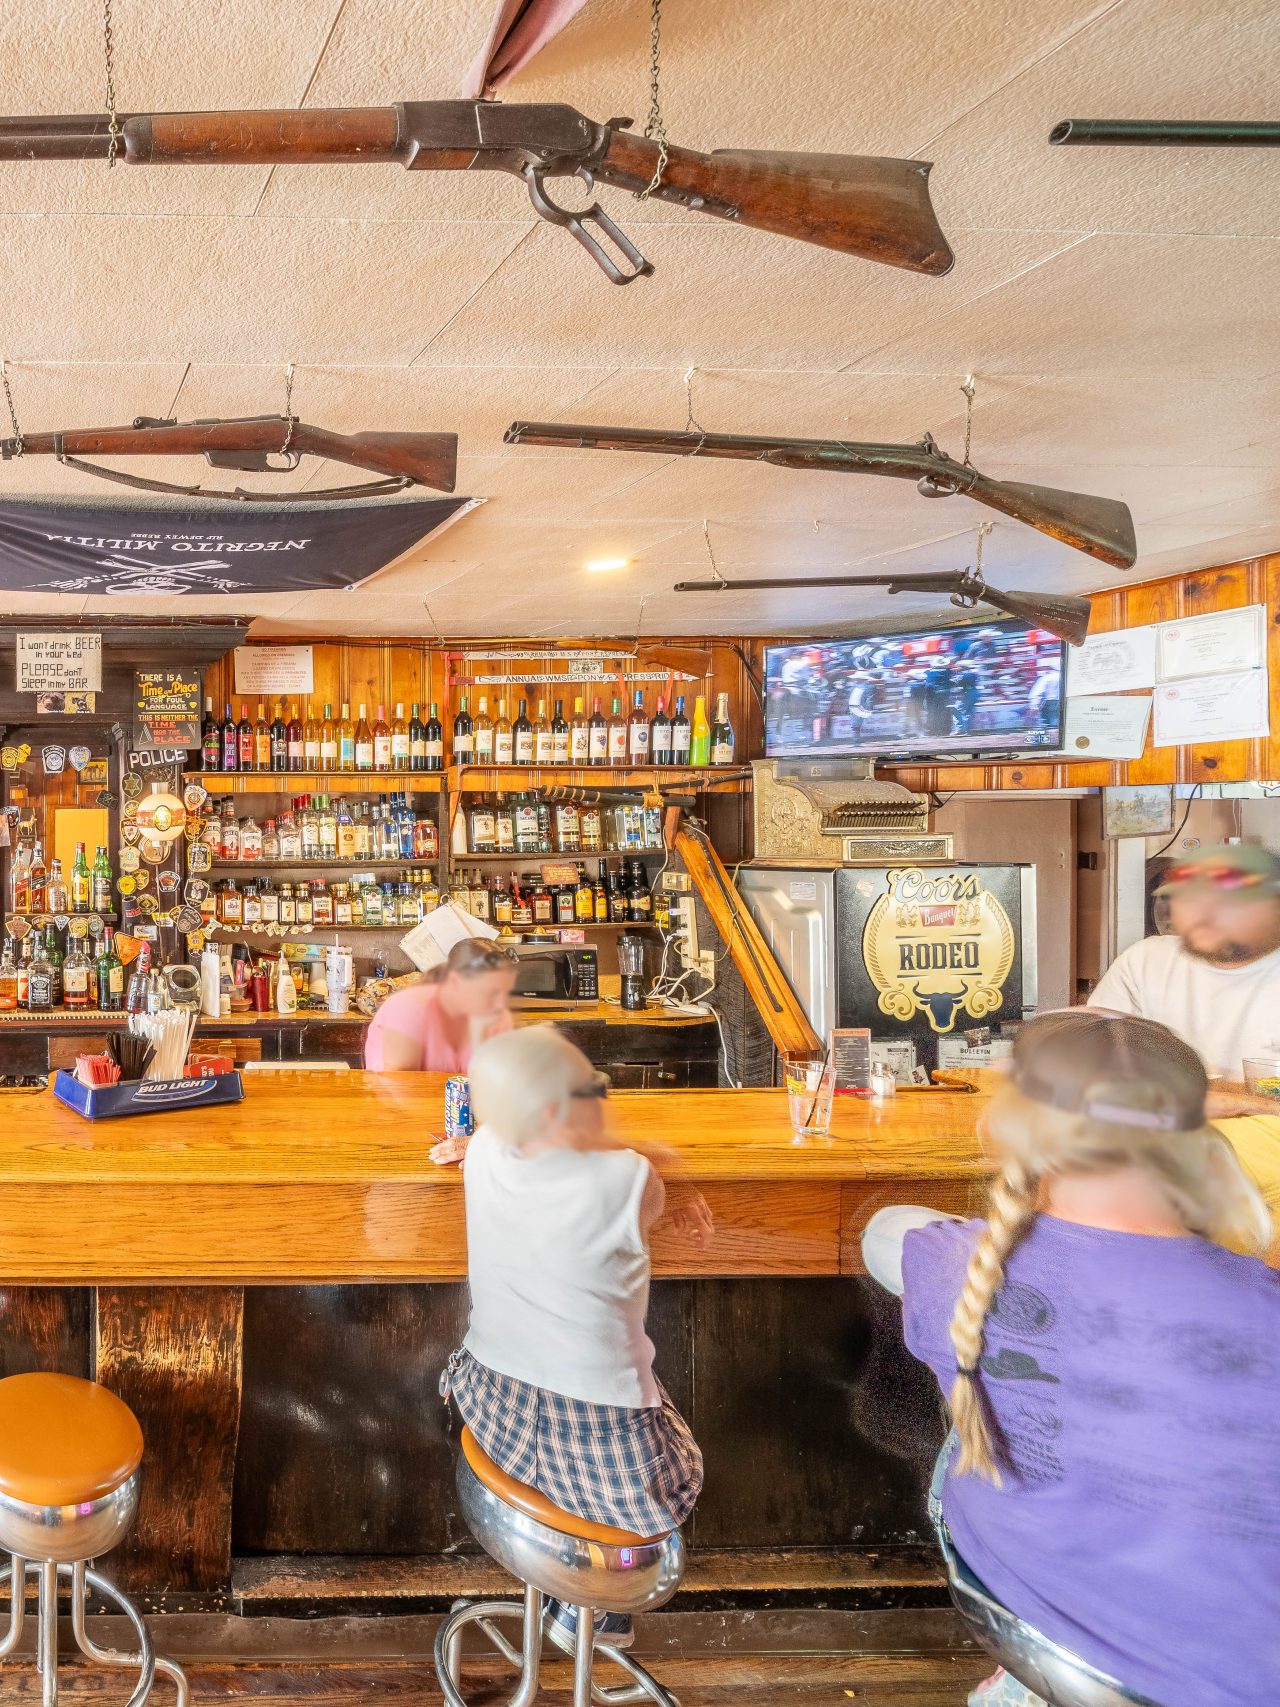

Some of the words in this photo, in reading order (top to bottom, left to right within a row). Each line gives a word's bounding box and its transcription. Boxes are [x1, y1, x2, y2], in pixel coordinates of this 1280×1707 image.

[44, 534, 165, 551] MILITIA
[171, 539, 312, 552] NEGRITO
[20, 637, 26, 650] I
[75, 637, 101, 650] BEER
[21, 662, 64, 677] PLEASE
[68, 677, 89, 689] BAR
[140, 674, 163, 682] THERE
[138, 682, 163, 696] Time
[172, 681, 198, 694] Place
[154, 736, 190, 744] PLACE
[129, 749, 186, 768] POLICE
[893, 870, 980, 903] Coors
[924, 909, 956, 926] Banquet
[899, 941, 980, 970] RODEO
[138, 1082, 167, 1095] BUD
[169, 1078, 210, 1091] LIGHT
